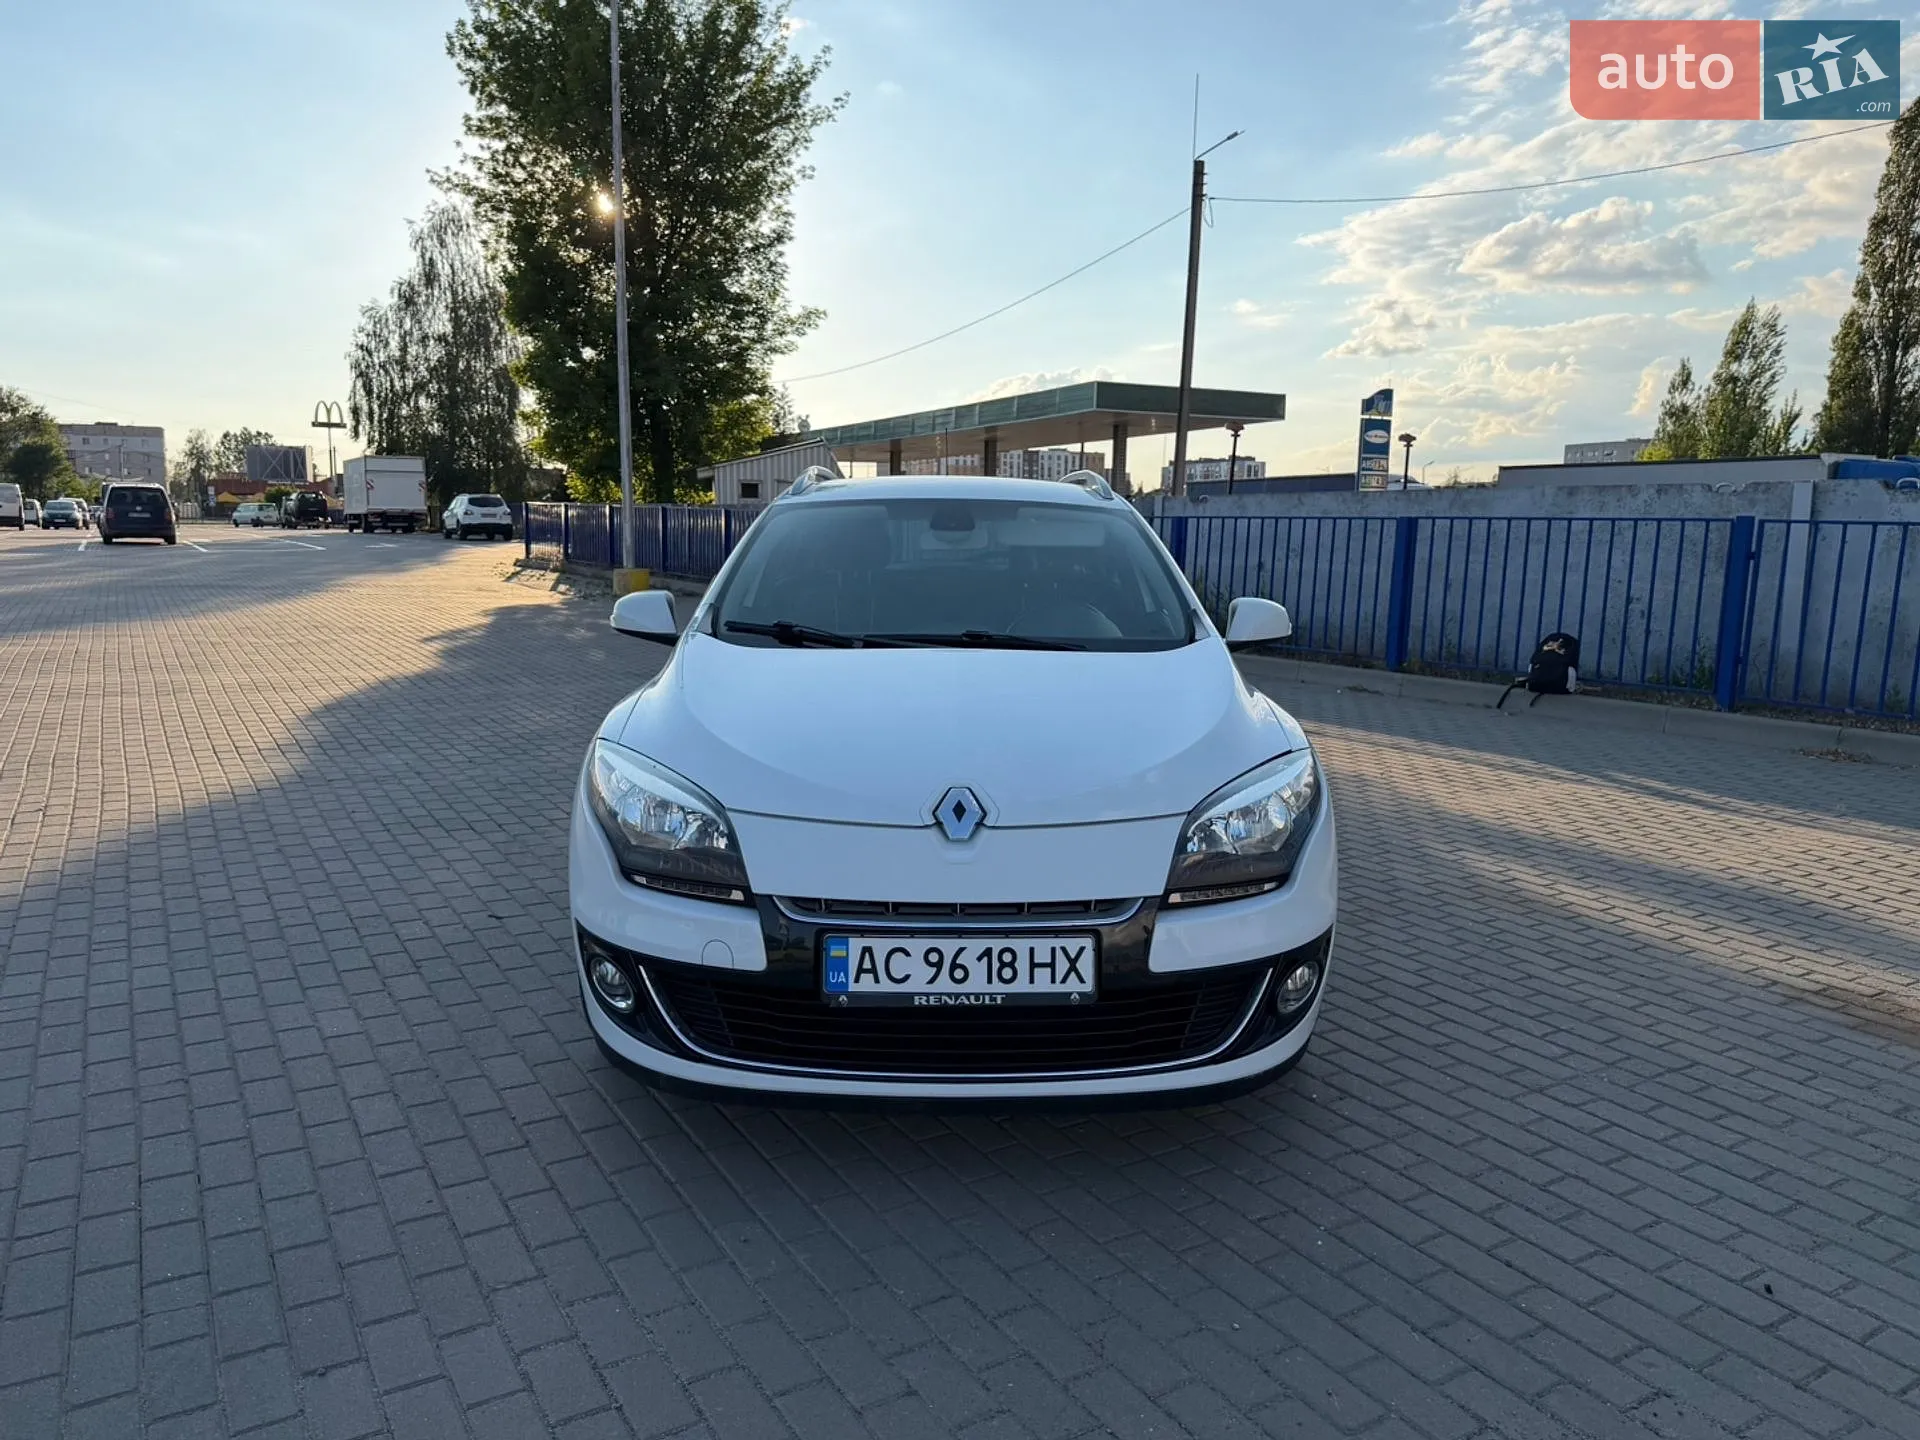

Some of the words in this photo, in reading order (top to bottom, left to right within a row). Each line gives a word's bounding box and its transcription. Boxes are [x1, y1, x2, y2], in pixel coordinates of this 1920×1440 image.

[853, 946, 912, 985] AC
[922, 946, 1019, 985] 9618
[1028, 946, 1087, 985] HX
[829, 971, 847, 984] UA
[913, 994, 1006, 1006] RENAULT
